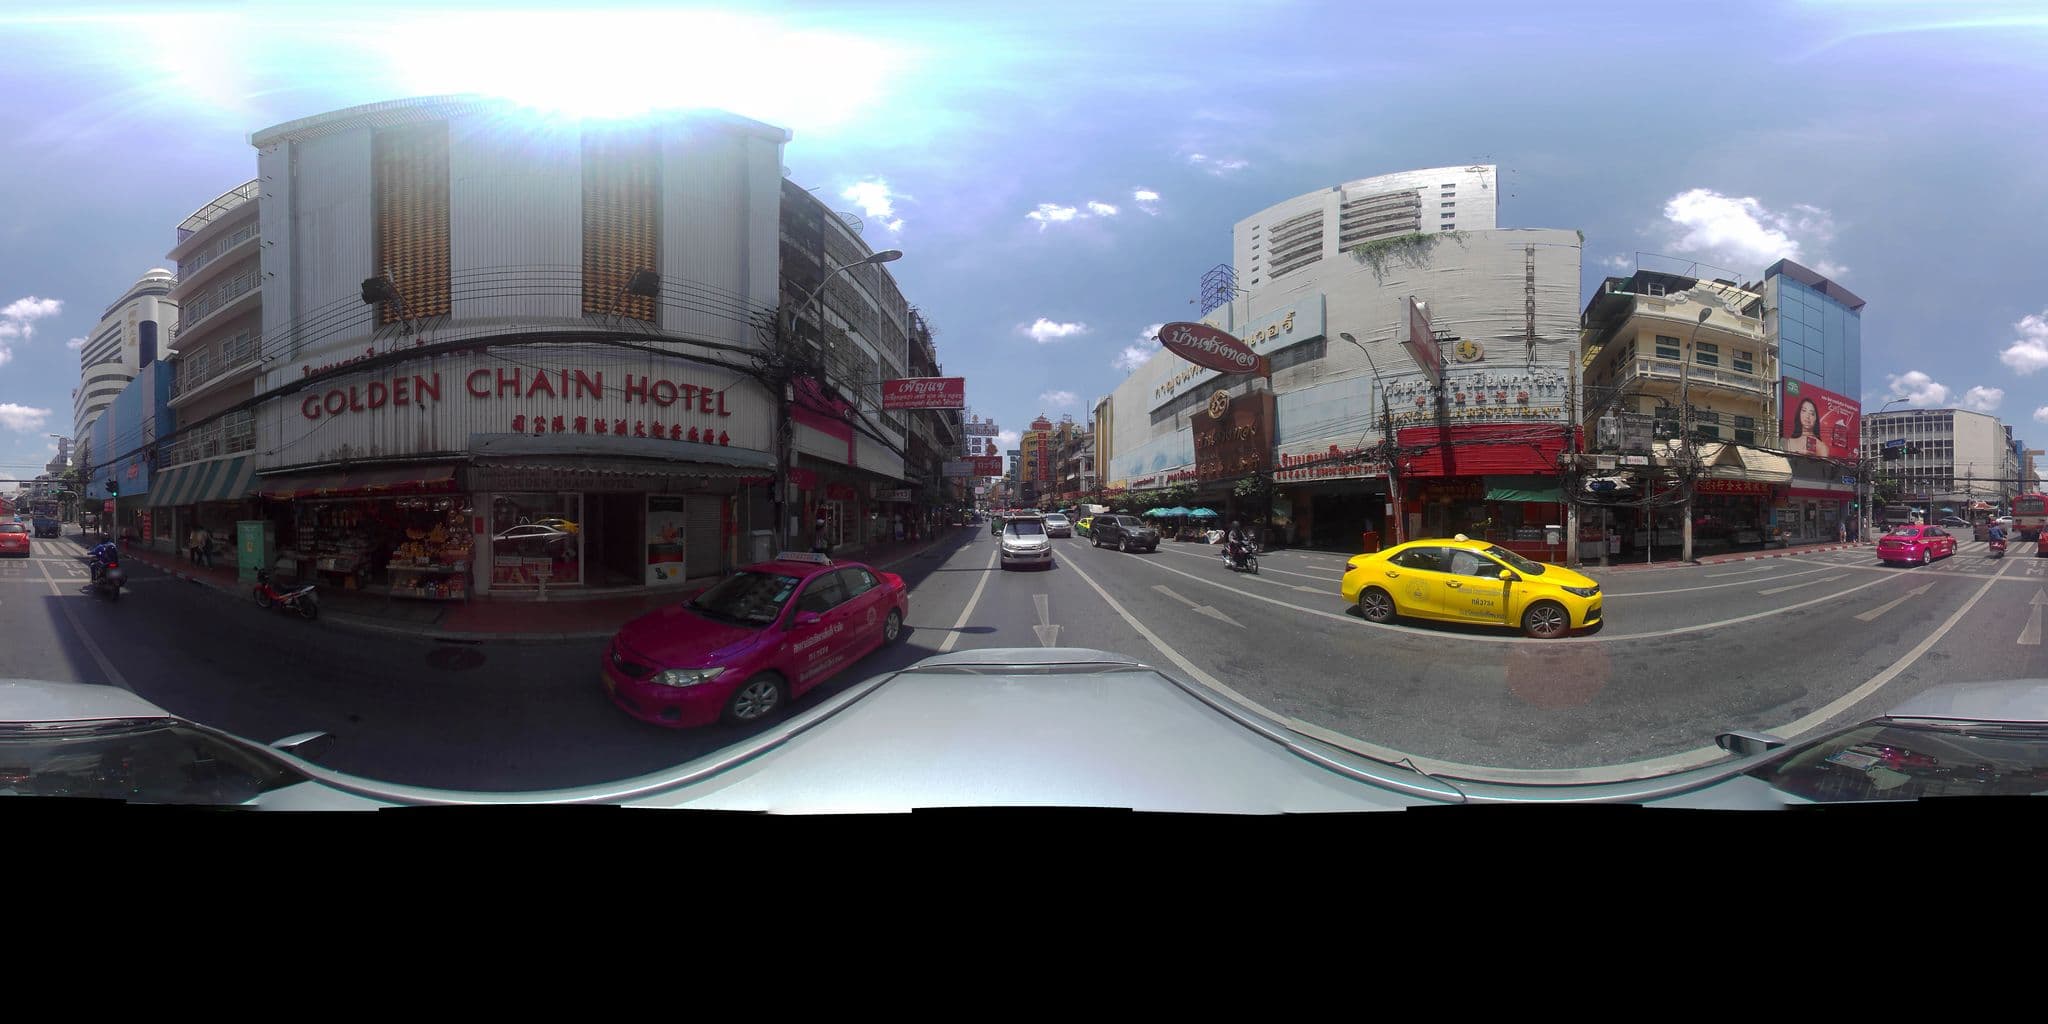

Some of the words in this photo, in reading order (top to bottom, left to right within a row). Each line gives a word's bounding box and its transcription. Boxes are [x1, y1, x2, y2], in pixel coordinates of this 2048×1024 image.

[1172, 326, 1256, 367] บ้านช้างทอง
[301, 372, 440, 420] GOLDEN
[466, 367, 604, 400] CHAIN
[625, 374, 732, 417] HOTEL
